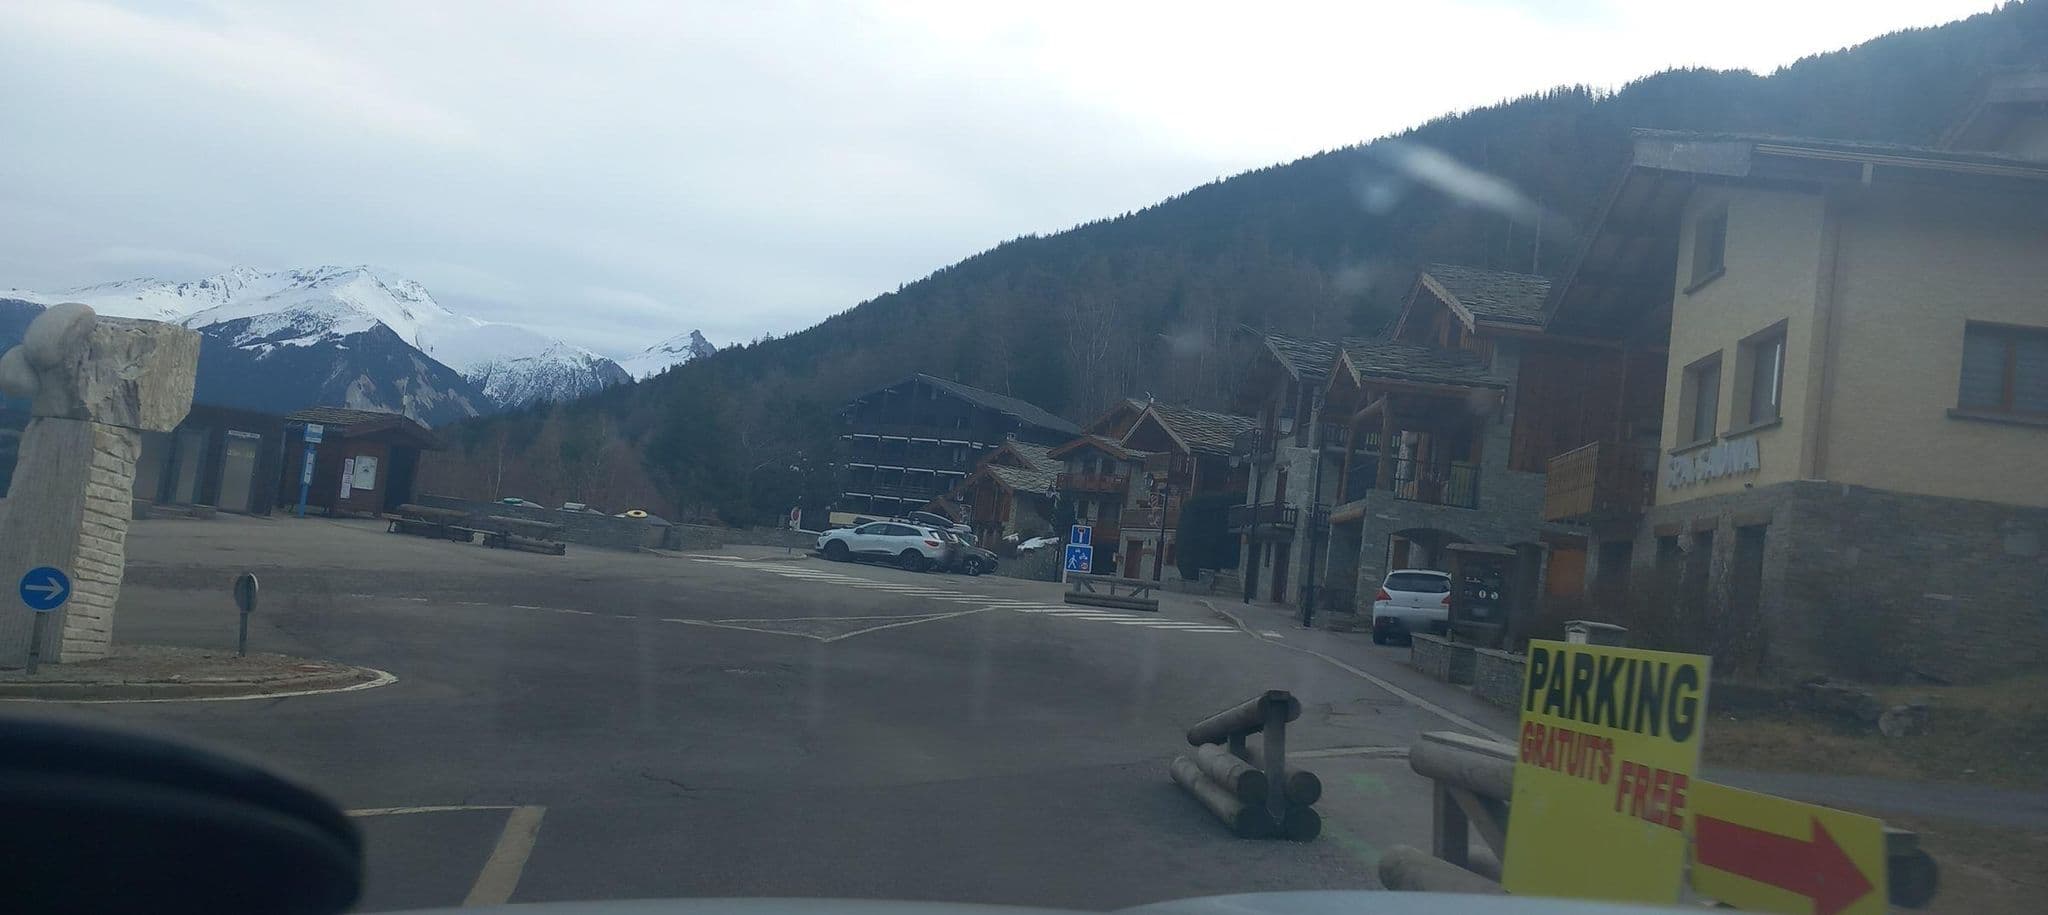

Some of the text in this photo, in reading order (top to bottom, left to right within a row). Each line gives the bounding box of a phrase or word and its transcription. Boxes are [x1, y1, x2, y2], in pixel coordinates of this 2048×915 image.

[1526, 647, 1699, 743] PARKING
[1521, 721, 1615, 785] GRATUITS
[1615, 760, 1689, 831] FREE
